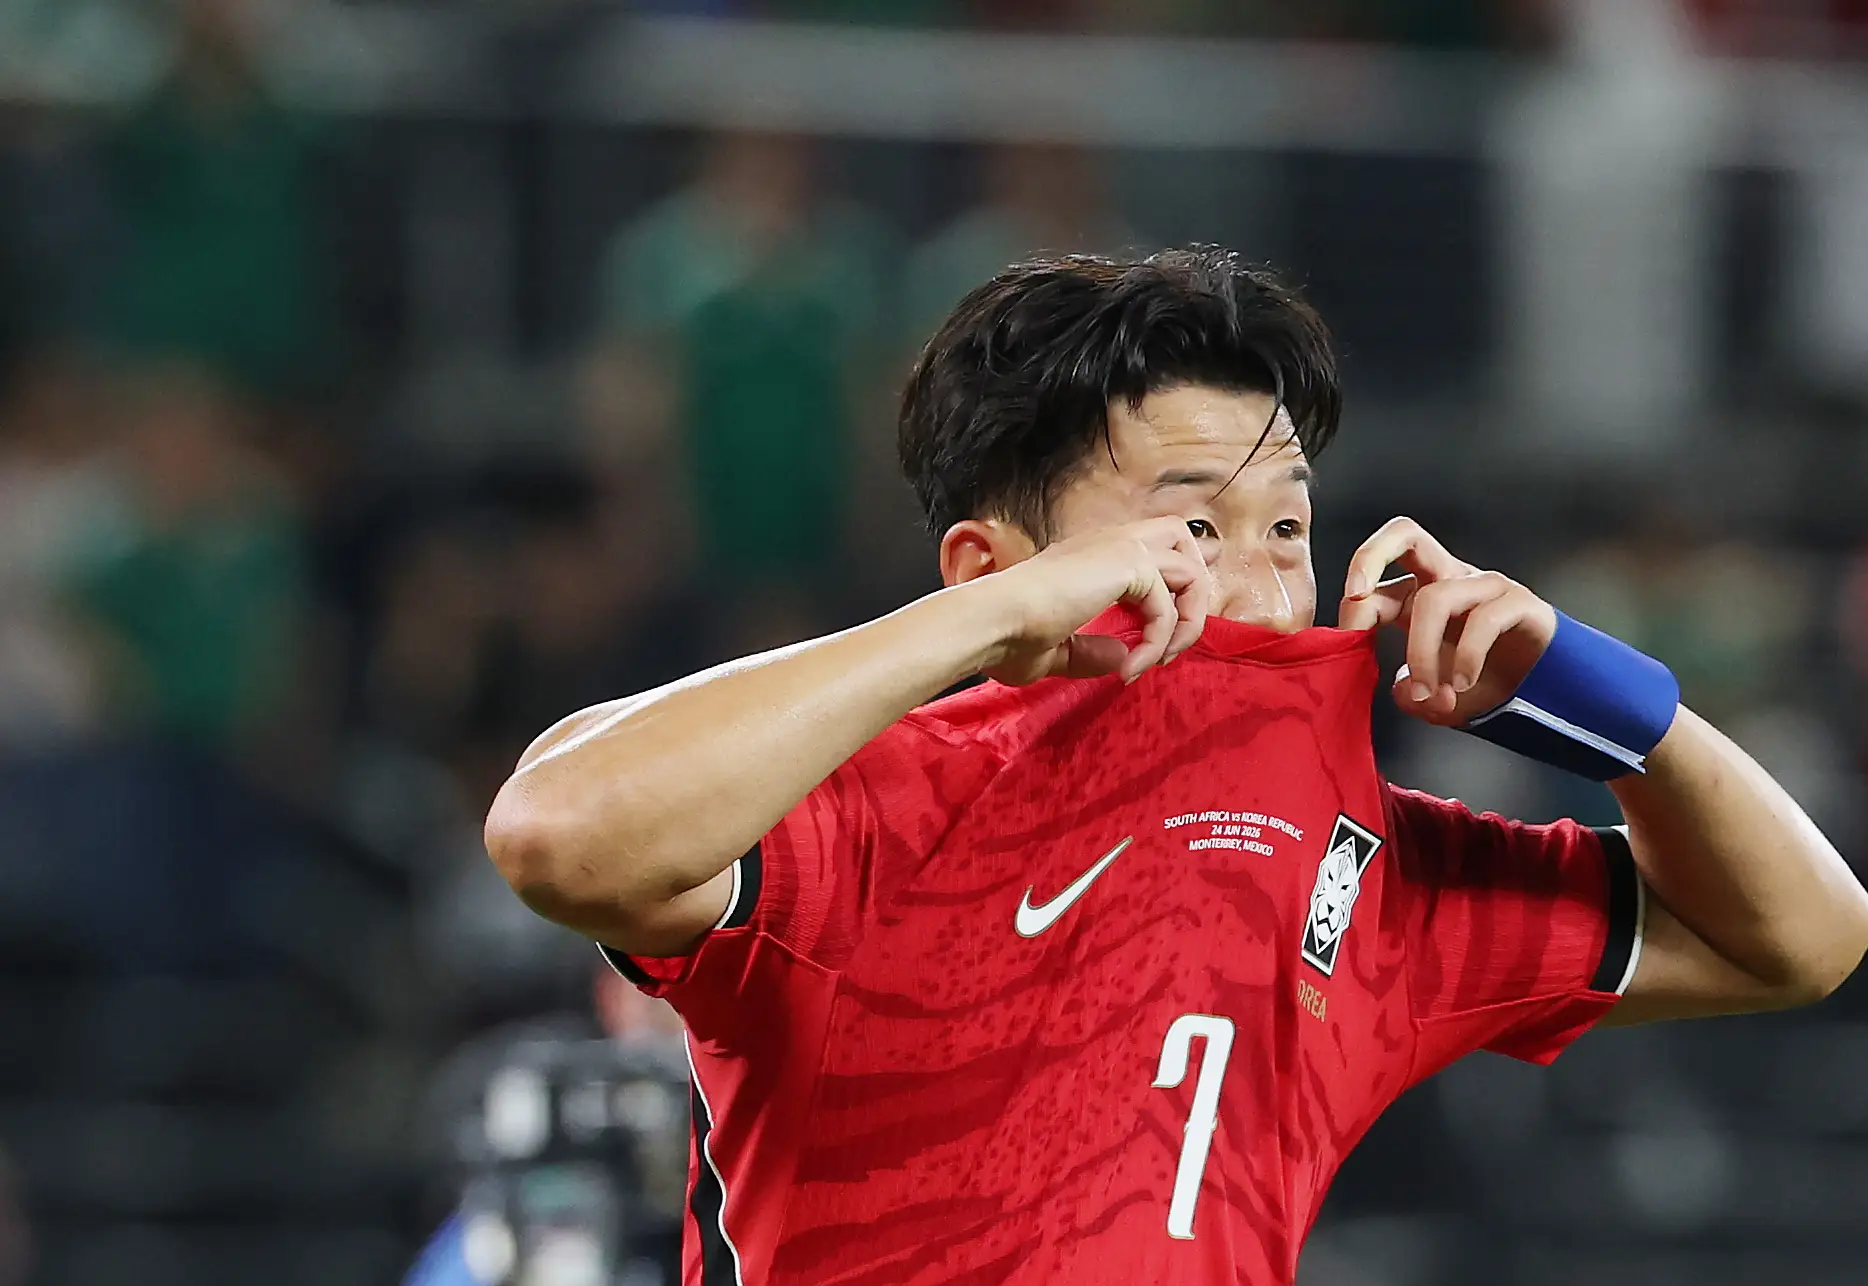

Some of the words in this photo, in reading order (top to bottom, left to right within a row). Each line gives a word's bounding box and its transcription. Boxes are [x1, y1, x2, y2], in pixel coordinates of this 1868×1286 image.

[1164, 812, 1198, 829] SOUTH
[1198, 811, 1230, 822] AFRICA
[1241, 811, 1268, 826] KOREA
[1268, 816, 1303, 841] REPUBLIC
[1211, 824, 1223, 836] 24
[1223, 824, 1241, 836] JUN
[1241, 825, 1262, 838] 2026
[1189, 837, 1243, 852] MONTERREY,
[1243, 839, 1274, 857] MEXICO
[1297, 978, 1328, 1023] OREA
[1150, 1013, 1236, 1240] 7
